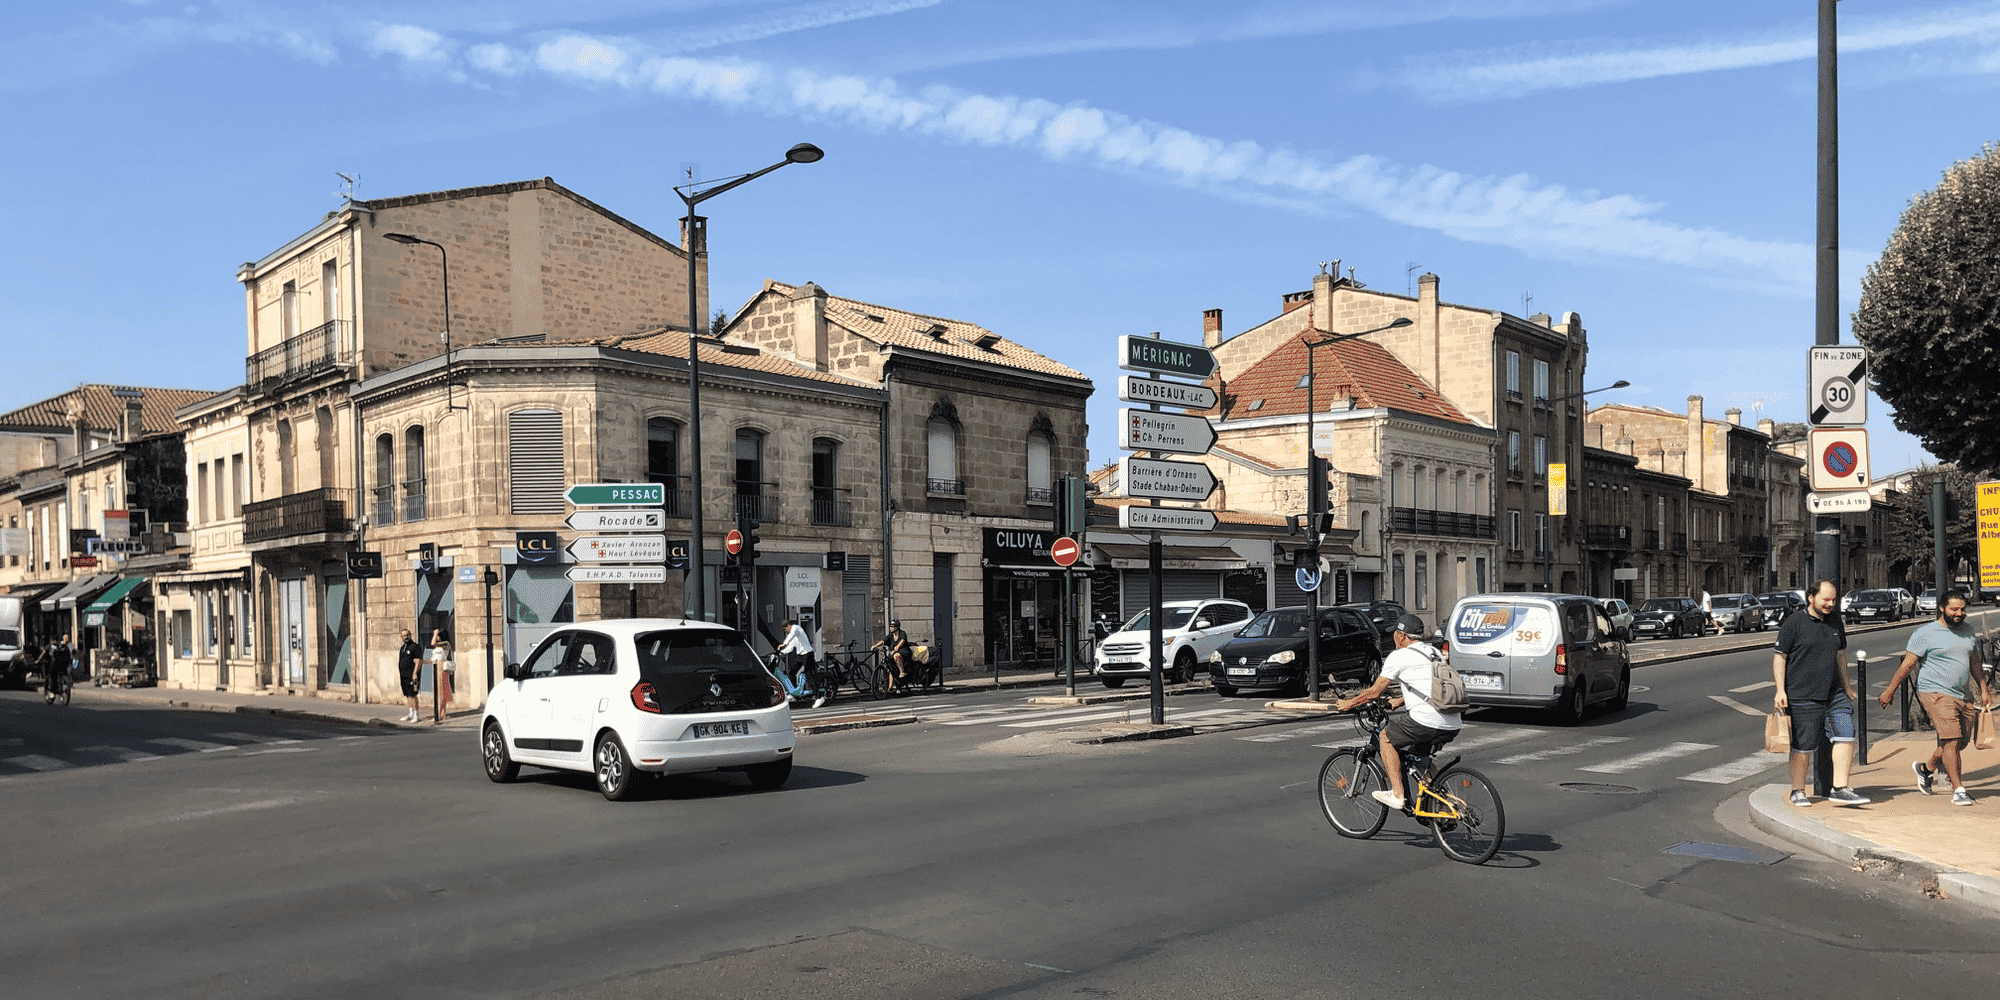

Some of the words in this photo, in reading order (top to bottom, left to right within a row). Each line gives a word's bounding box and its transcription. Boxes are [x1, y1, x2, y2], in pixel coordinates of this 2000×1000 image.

[1132, 344, 1192, 368] MÉRIGNAC
[1814, 351, 1829, 360] FIN
[1839, 351, 1863, 360] ZONE
[1828, 387, 1849, 402] 30
[1142, 418, 1176, 432] Pellegrin
[1142, 432, 1154, 442] Ch.
[1158, 433, 1185, 445] Perrens
[1132, 465, 1162, 477] Barrière
[1165, 468, 1198, 480] d'Ornano
[1132, 480, 1152, 491] Stade
[1154, 481, 1204, 494] Chaban-Delmas
[1983, 486, 2000, 496] INF
[612, 489, 659, 500] PESSAC
[1980, 507, 1999, 516] CHU
[599, 516, 643, 526] Rocade
[1132, 512, 1149, 523] Cité
[1151, 513, 1204, 525] Administrative
[1980, 522, 1999, 530] Rue
[519, 539, 552, 551] LCL
[996, 531, 1043, 549] CILUYA
[92, 542, 143, 552] FLEURS
[667, 546, 687, 557] LCL
[420, 549, 434, 561] LCL
[350, 557, 379, 568] LCL
[1516, 630, 1542, 642] 39€
